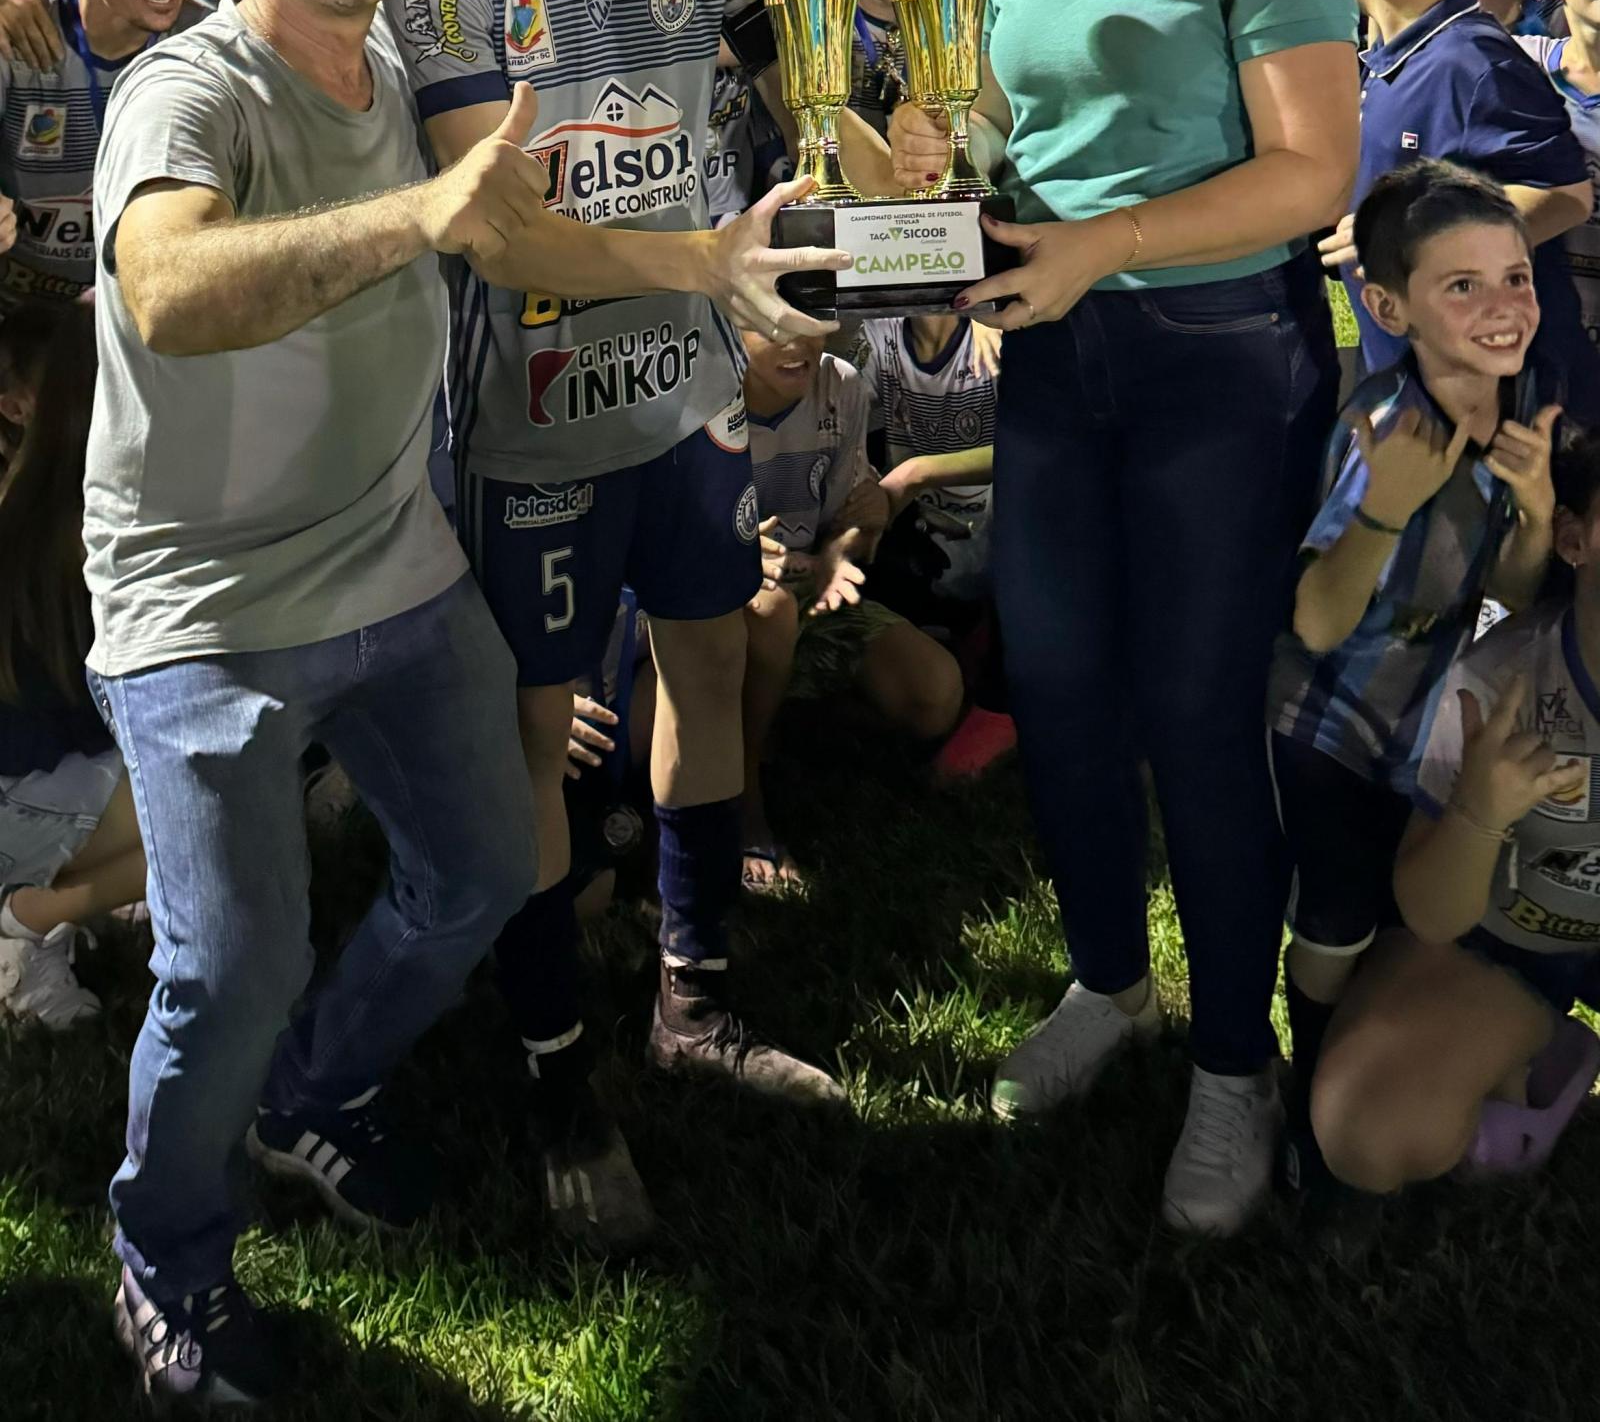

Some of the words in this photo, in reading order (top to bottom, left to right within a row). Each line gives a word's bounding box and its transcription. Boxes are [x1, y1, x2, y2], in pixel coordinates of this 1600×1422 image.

[594, 198, 611, 220] DE
[615, 174, 696, 215] CONSTRUÇO
[850, 214, 892, 222] CAMPEONATO
[870, 232, 891, 242] TAÇA
[903, 227, 947, 239] SICOOB
[578, 323, 673, 369] GRUPO
[541, 546, 576, 634] 5
